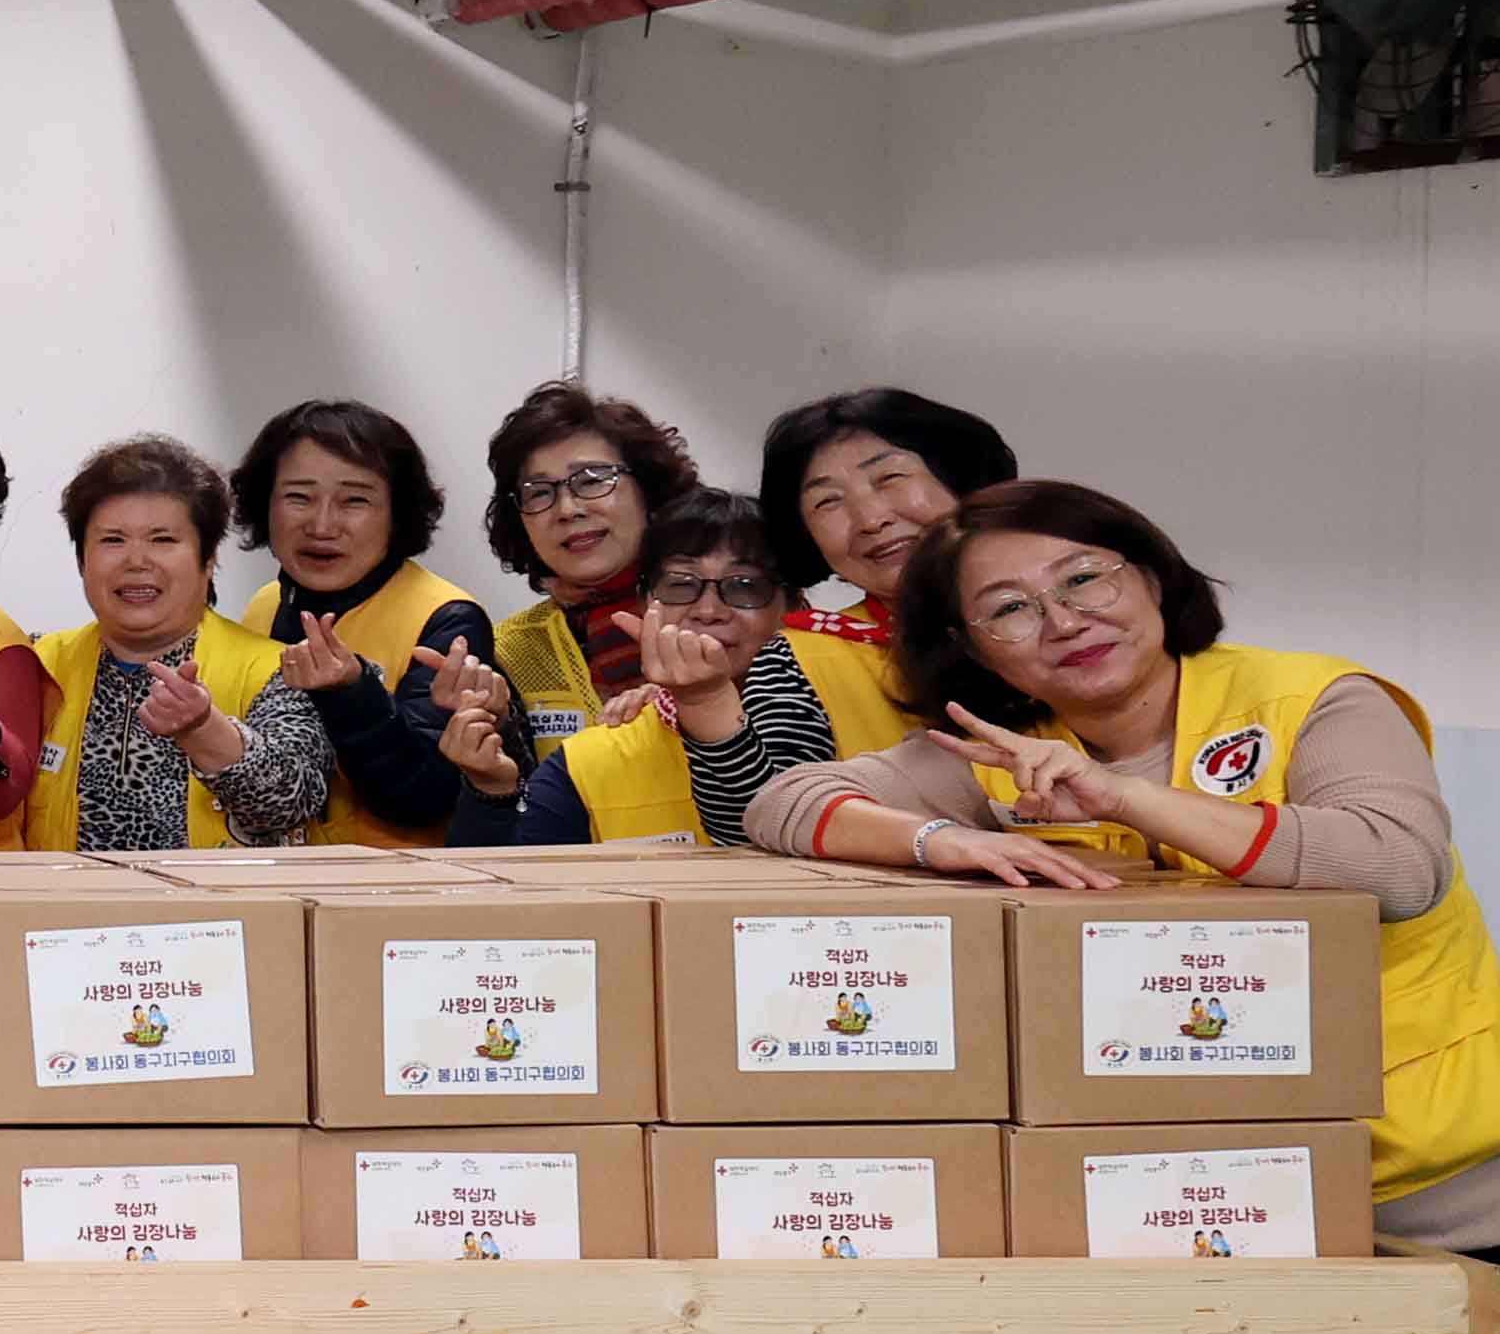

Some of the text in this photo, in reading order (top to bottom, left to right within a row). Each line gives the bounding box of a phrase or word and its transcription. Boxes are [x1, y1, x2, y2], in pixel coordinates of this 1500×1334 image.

[825, 948, 870, 964] 적십자
[117, 958, 164, 977] 적십자
[787, 969, 909, 988] 사랑의 김장나눔
[81, 978, 204, 1003] 사랑의 김장나눔
[786, 1039, 938, 1058] 봉사회 동구지구협의회
[83, 1047, 237, 1073] 봉사회 동구지구협의회
[450, 1186, 497, 1203] 적십자
[1179, 1184, 1227, 1203] 적십자
[413, 1208, 538, 1227] 사랑의 김장나눔
[1141, 1205, 1269, 1229] 사랑의 김장나눔
